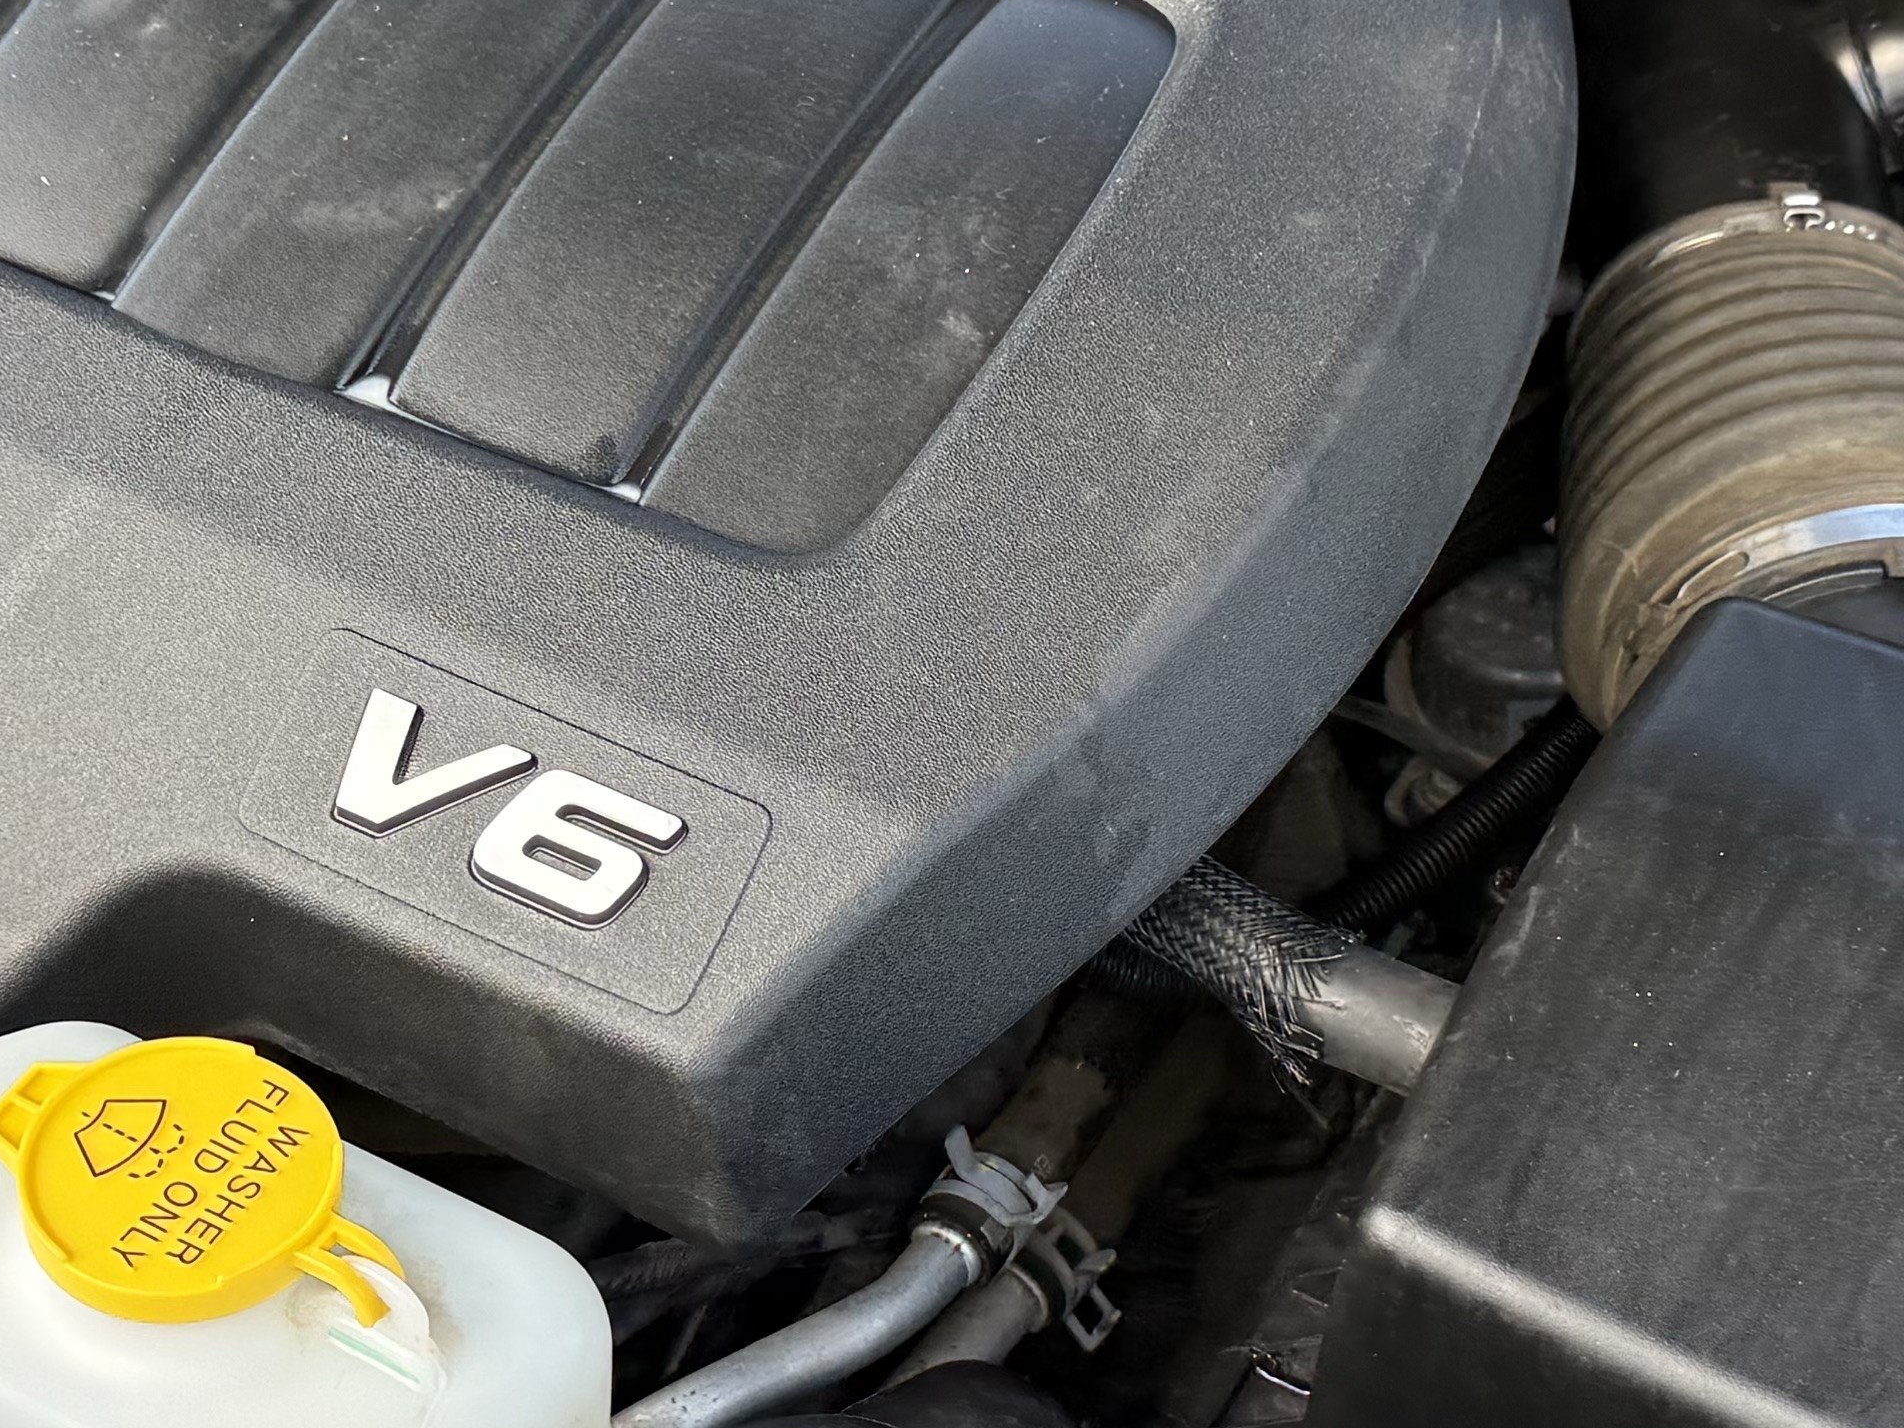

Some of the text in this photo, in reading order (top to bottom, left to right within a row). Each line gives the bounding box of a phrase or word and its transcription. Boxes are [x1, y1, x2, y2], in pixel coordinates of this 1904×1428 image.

[333, 687, 689, 931] V6
[110, 1078, 291, 1269] FLUID ONLY
[164, 1124, 310, 1267] WASHER
